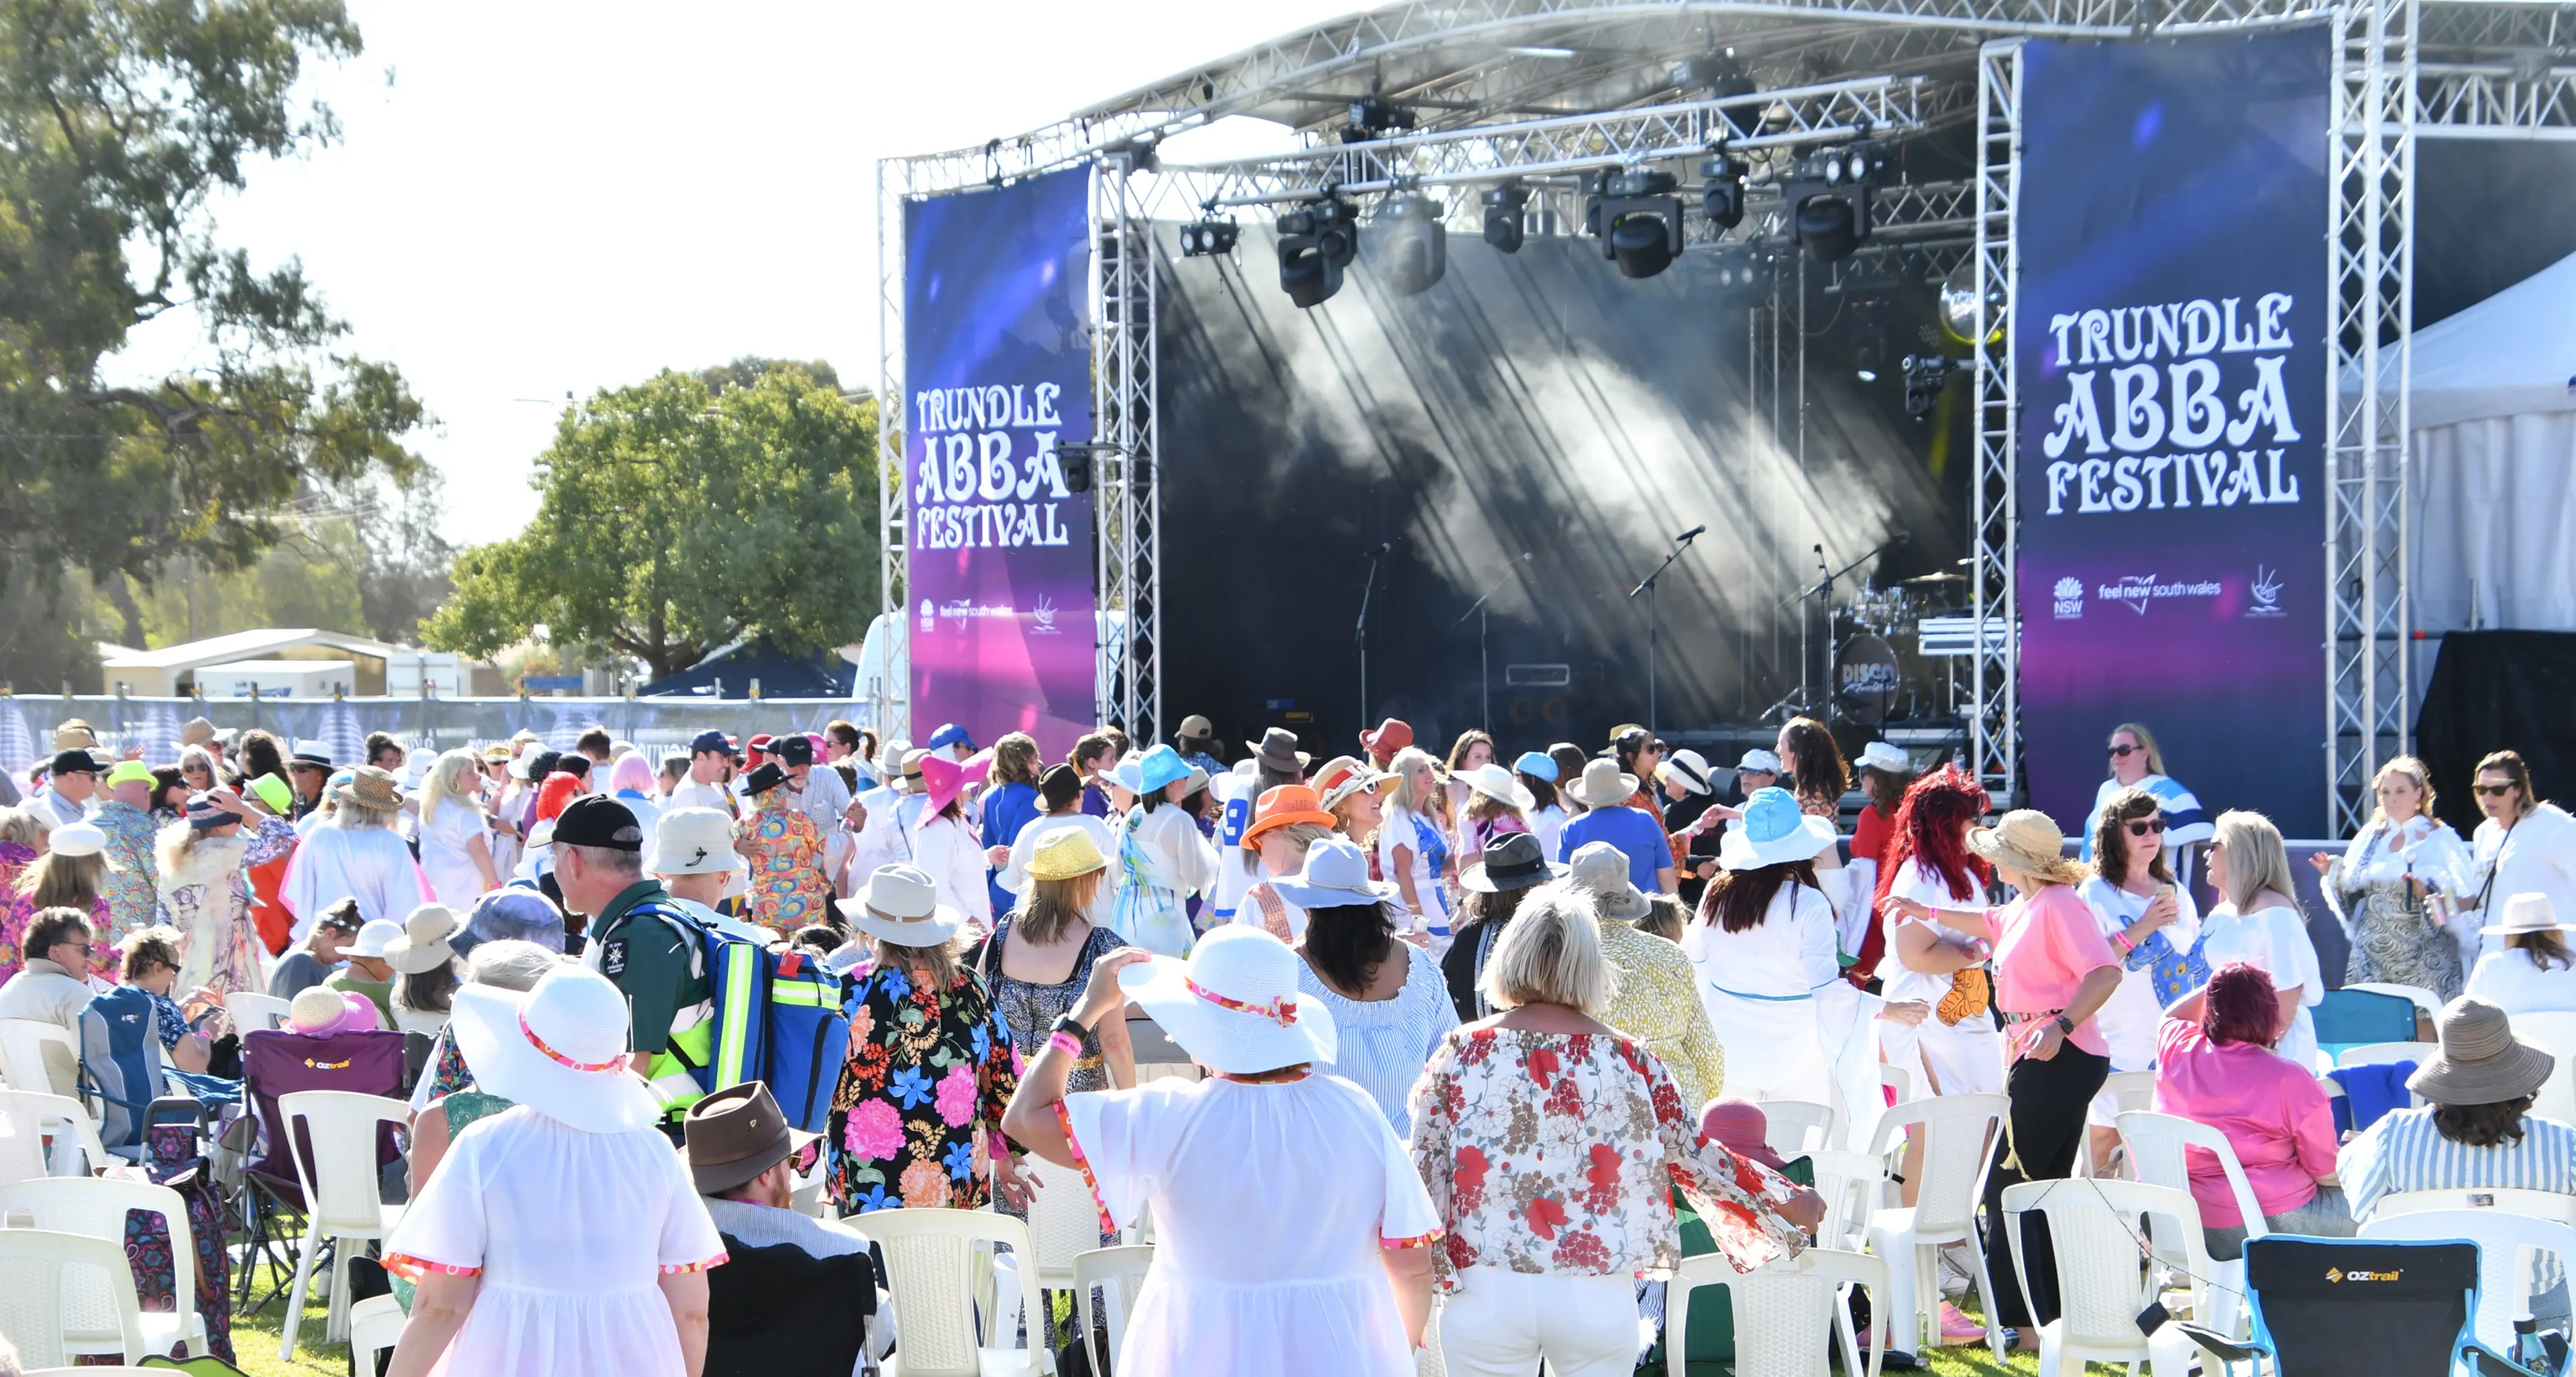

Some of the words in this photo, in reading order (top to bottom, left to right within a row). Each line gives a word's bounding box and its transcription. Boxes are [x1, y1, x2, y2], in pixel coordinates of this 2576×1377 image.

[2049, 292, 2293, 366] TRUNDLE
[916, 382, 1062, 433] TRUNDLE
[2044, 355, 2300, 457] ABBA
[915, 431, 1071, 504] ABBA
[2047, 449, 2300, 514] FESTIVAL
[916, 502, 1069, 549] FESTIVAL
[940, 605, 953, 618] feel
[953, 606, 968, 616] new
[968, 604, 989, 618] south
[2054, 600, 2083, 614] NSW
[2098, 584, 2123, 600] feel
[2124, 585, 2151, 598] new
[2152, 581, 2186, 598] south
[2188, 580, 2220, 596] wales
[1842, 663, 1895, 683] DISCO
[1223, 798, 1248, 846] 9
[2347, 1271, 2399, 1281] OZtrail
